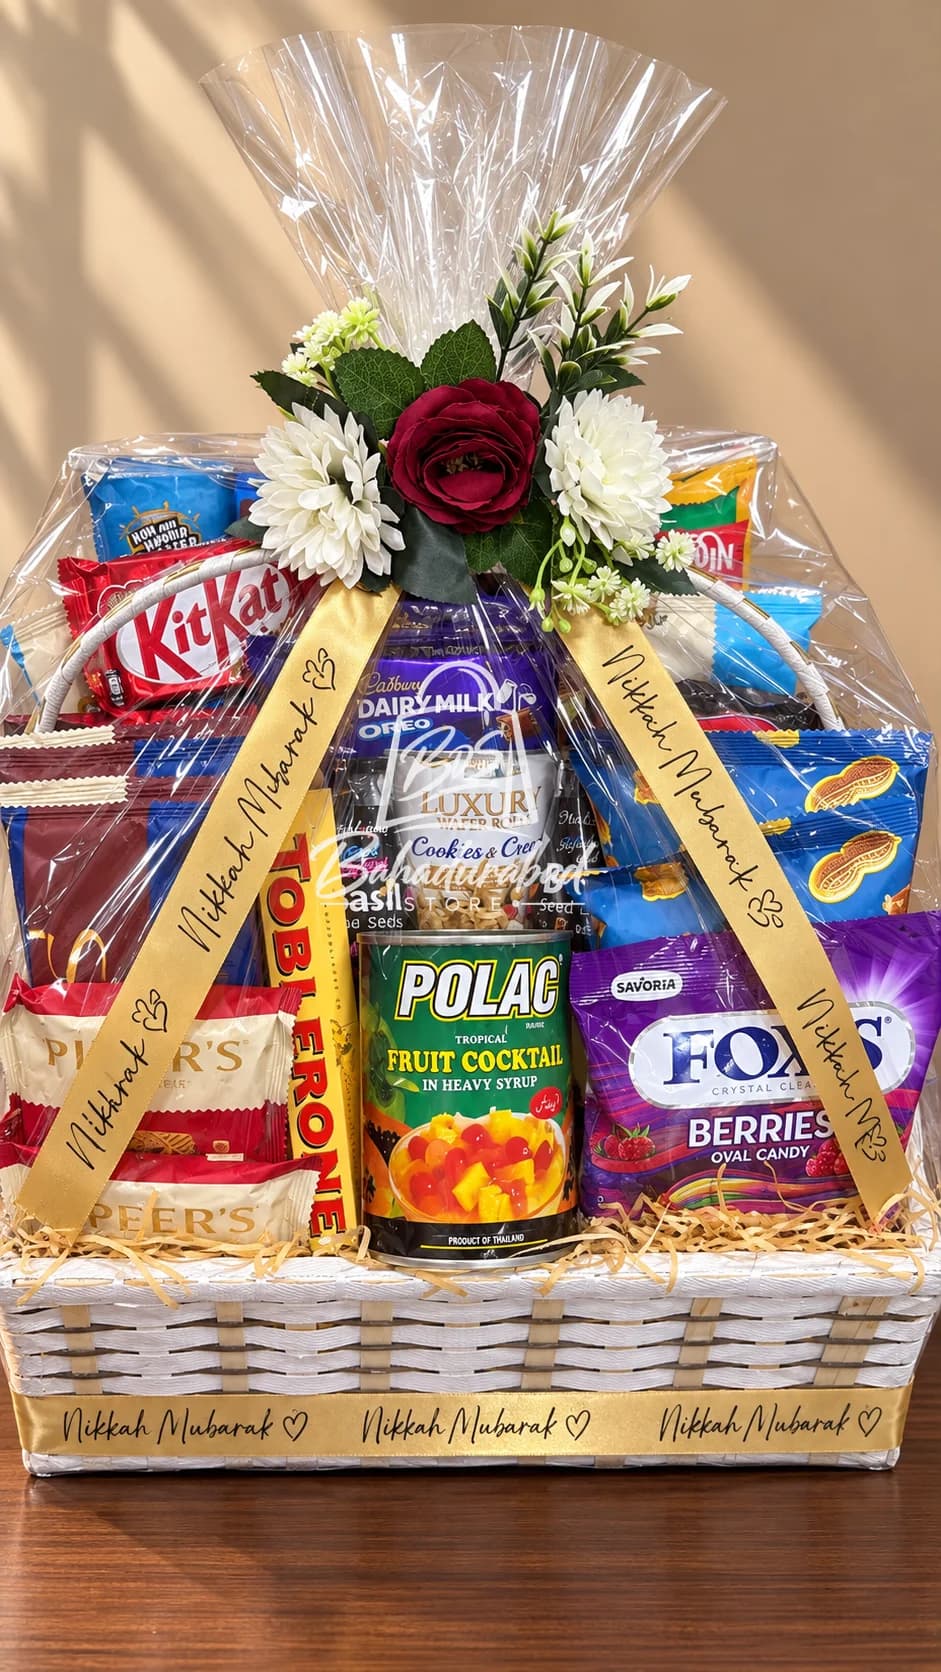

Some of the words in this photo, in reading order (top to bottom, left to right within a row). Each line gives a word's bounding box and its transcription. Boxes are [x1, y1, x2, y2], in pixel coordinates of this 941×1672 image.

[132, 567, 281, 681] KitKat
[358, 671, 424, 695] Cadbury
[358, 694, 432, 719] DAIRY
[435, 693, 497, 714] MILK
[358, 718, 431, 739] OREO
[602, 644, 678, 752] Nikkah
[658, 749, 759, 892] Mubarak
[411, 835, 483, 859] Cookes
[485, 845, 498, 859] &
[177, 831, 256, 952] Nikkah
[345, 882, 403, 912] asil
[396, 956, 560, 1020] POLAC
[455, 1034, 507, 1045] TROPICAL
[663, 1016, 884, 1085] FOXS
[797, 988, 860, 1101] Nikkah
[387, 1048, 456, 1073] FRUIT
[461, 1045, 564, 1073] COCKTAIL
[423, 1078, 438, 1092] IN
[442, 1077, 491, 1092] HEAVY
[496, 1075, 538, 1090] SYRUP
[712, 1084, 773, 1096] CRYSTAL
[779, 1079, 817, 1092] CLEA
[688, 1110, 835, 1148] BERRIES
[711, 1150, 753, 1164] OVAL
[756, 1145, 811, 1162] CANDY
[88, 1203, 256, 1235] PEER'S
[448, 1236, 480, 1246] PRODUCT
[482, 1235, 492, 1245] OF
[493, 1233, 525, 1244] THAILAND
[63, 1406, 152, 1443] Nikkah
[156, 1407, 274, 1445] Mubarak
[361, 1405, 446, 1443] Nikkah
[448, 1406, 558, 1445] Mubarak
[658, 1404, 742, 1442] Nikkah
[743, 1403, 852, 1442] Mubarak
